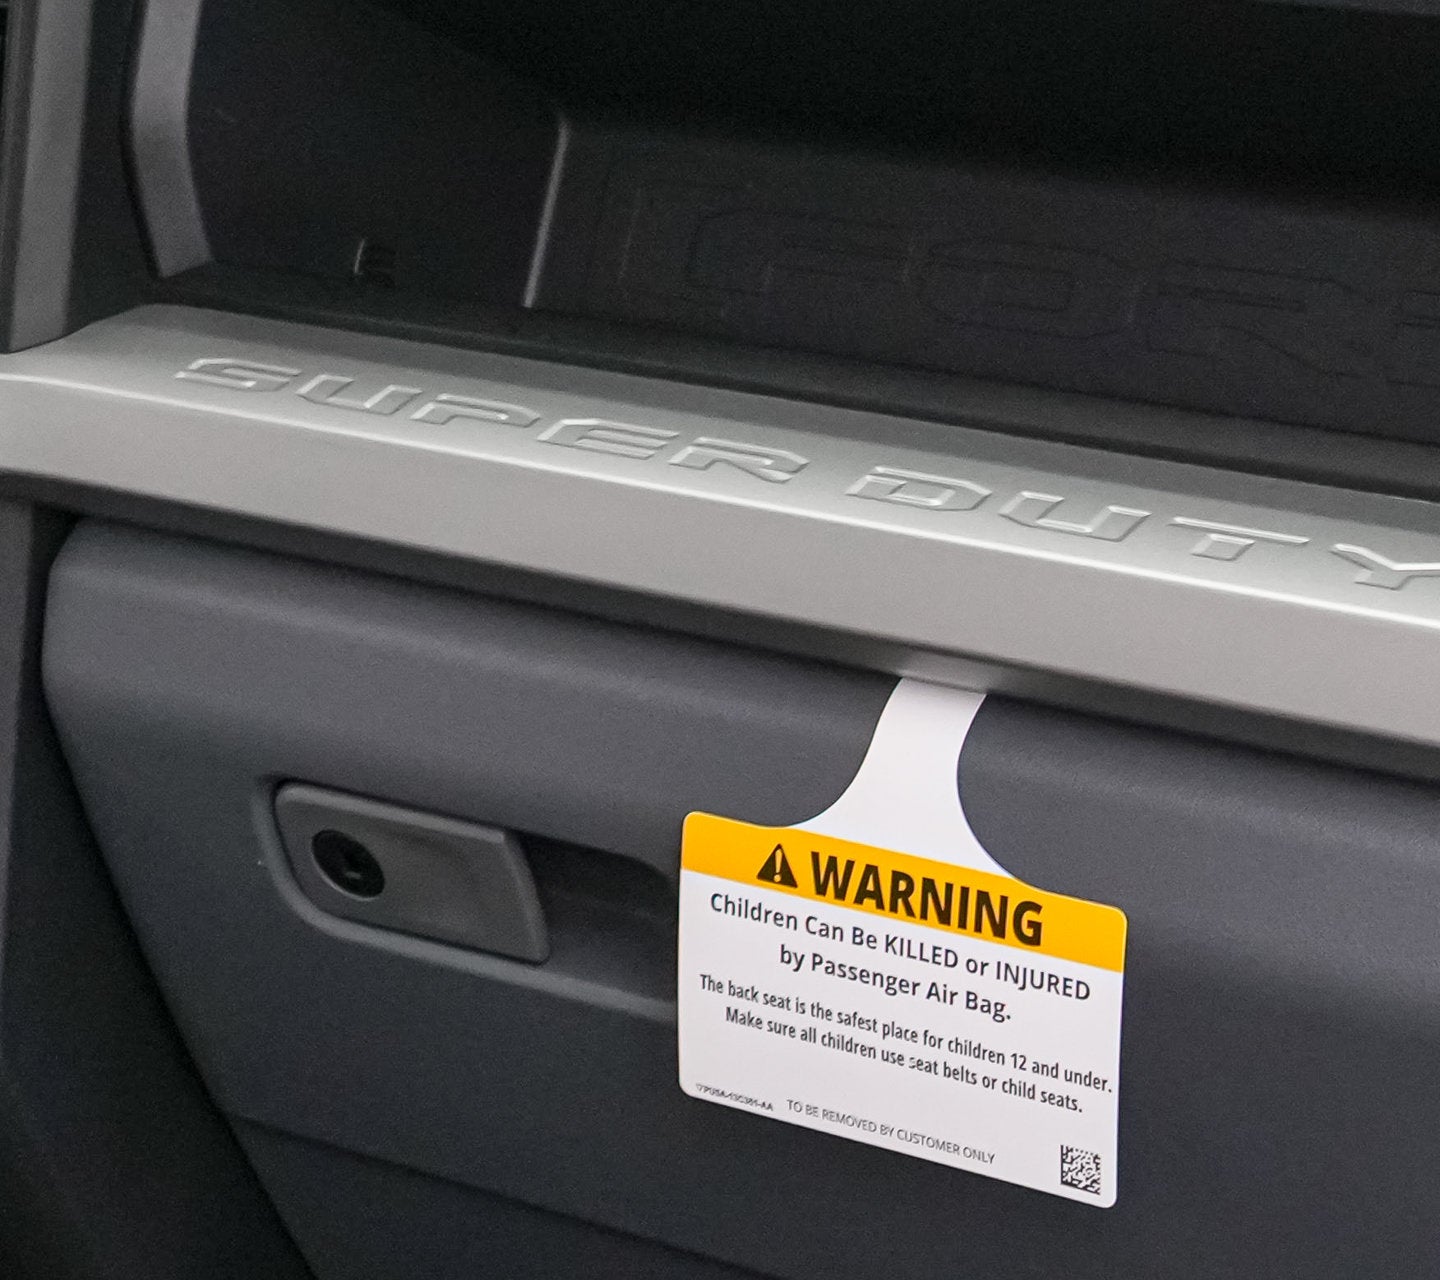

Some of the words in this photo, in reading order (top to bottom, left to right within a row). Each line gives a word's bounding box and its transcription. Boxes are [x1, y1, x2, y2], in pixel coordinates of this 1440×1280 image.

[174, 356, 812, 484] SUPER
[710, 892, 798, 931] Children
[805, 915, 844, 942] Can
[851, 926, 878, 950] Be
[884, 934, 959, 969] KILLED
[965, 957, 989, 977] or
[995, 960, 1091, 1001] INJURED
[810, 850, 1044, 947] WARNING
[699, 973, 724, 994] The
[727, 980, 759, 1004] back
[762, 992, 792, 1012] seat
[794, 996, 806, 1015] is
[810, 1001, 833, 1022] the
[836, 1011, 878, 1034] safest
[881, 1020, 919, 1044] place
[922, 1029, 944, 1050] for
[947, 1036, 1006, 1067] children
[1009, 1052, 1027, 1071] 12
[1031, 1060, 1060, 1080] and
[1064, 1068, 1113, 1094] under.
[780, 943, 806, 972] by
[811, 952, 921, 997] Passenger
[925, 981, 959, 1006] Air
[965, 990, 1011, 1023] Bag.
[725, 1006, 763, 1030] Make
[766, 1019, 796, 1039] sure
[799, 1026, 817, 1044] all
[820, 1032, 877, 1060] children
[880, 1047, 905, 1067] use
[908, 1056, 939, 1076] seat
[942, 1061, 978, 1086] belts
[981, 1074, 998, 1091] or
[1001, 1077, 1037, 1101] child
[1040, 1089, 1084, 1113] seats.
[786, 1098, 803, 1114] TO
[805, 1103, 819, 1118] BE
[821, 1108, 877, 1134] REMOVED
[880, 1123, 895, 1138] BY
[897, 1128, 961, 1156] CUSTOMER
[963, 1146, 996, 1165] ONLY
